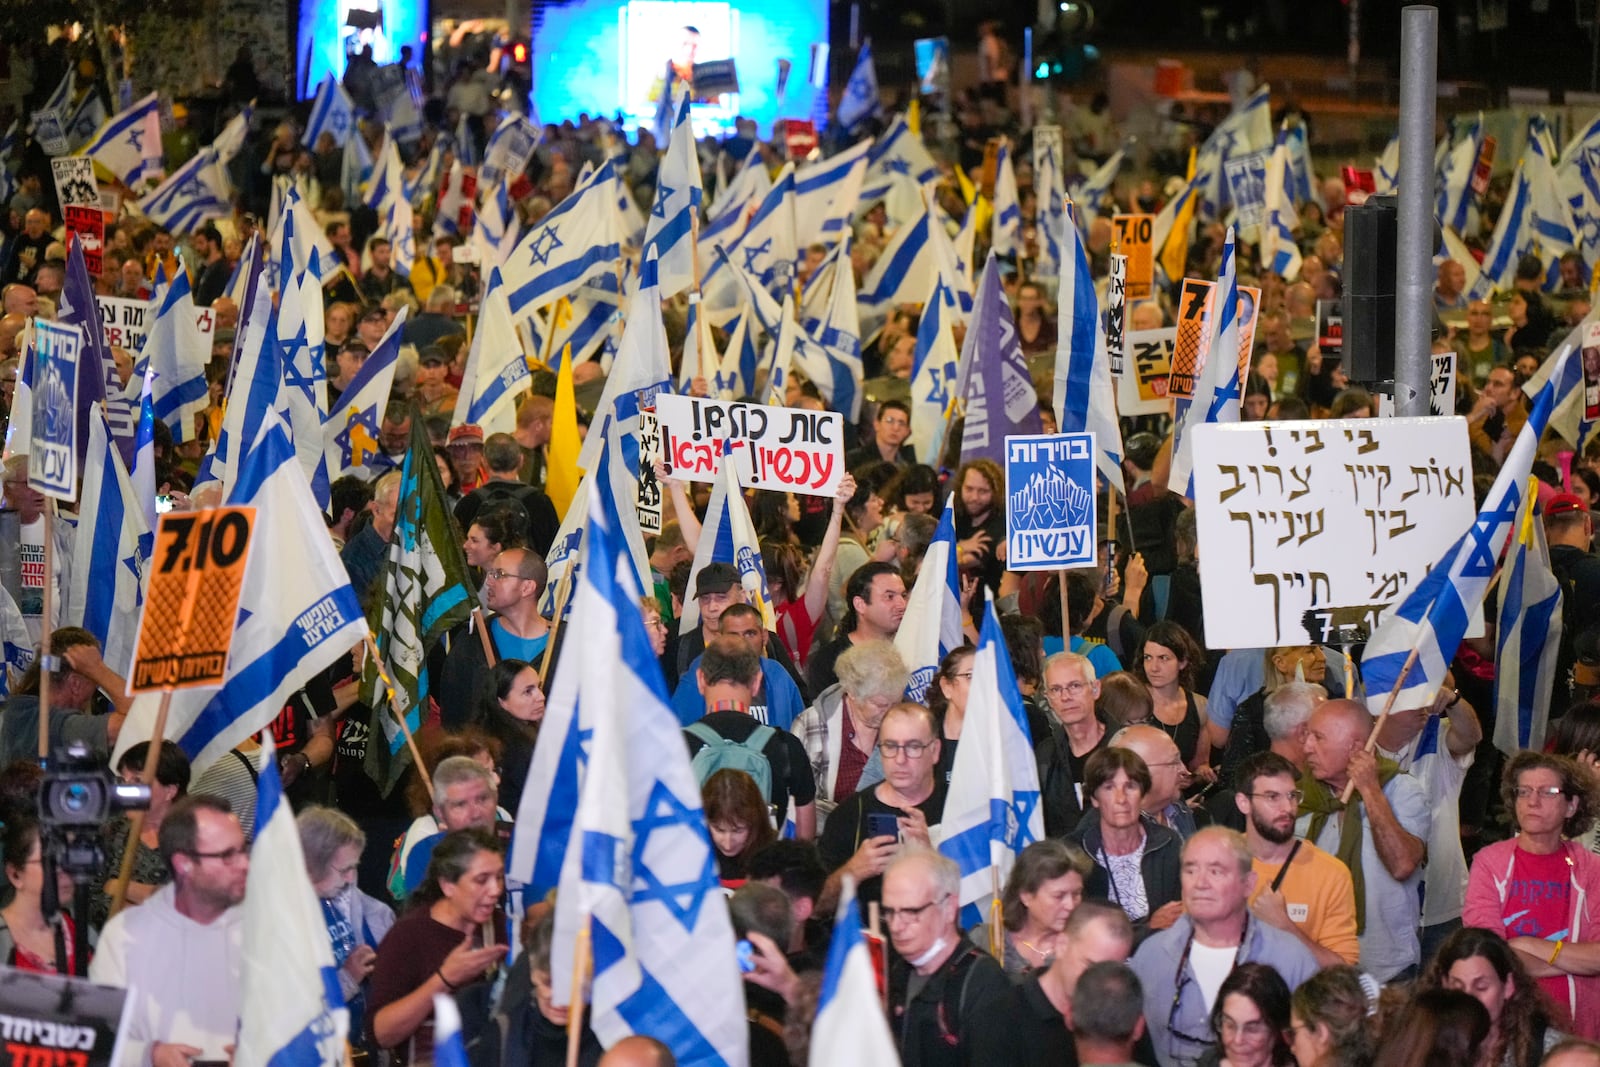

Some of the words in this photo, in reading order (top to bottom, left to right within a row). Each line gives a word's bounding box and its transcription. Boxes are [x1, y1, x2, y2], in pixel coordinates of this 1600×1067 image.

[1115, 218, 1152, 244] 7.10
[1184, 282, 1254, 328] 7.0
[1010, 440, 1090, 463] בחירות
[1343, 429, 1380, 455] בי
[1217, 463, 1312, 504] צרוב
[1343, 463, 1392, 505] קיין
[158, 511, 250, 574] 7.10
[1018, 529, 1086, 559] עכשיו!
[1364, 508, 1417, 556] בין
[1365, 570, 1408, 601] ימי
[1252, 570, 1331, 645] חייך
